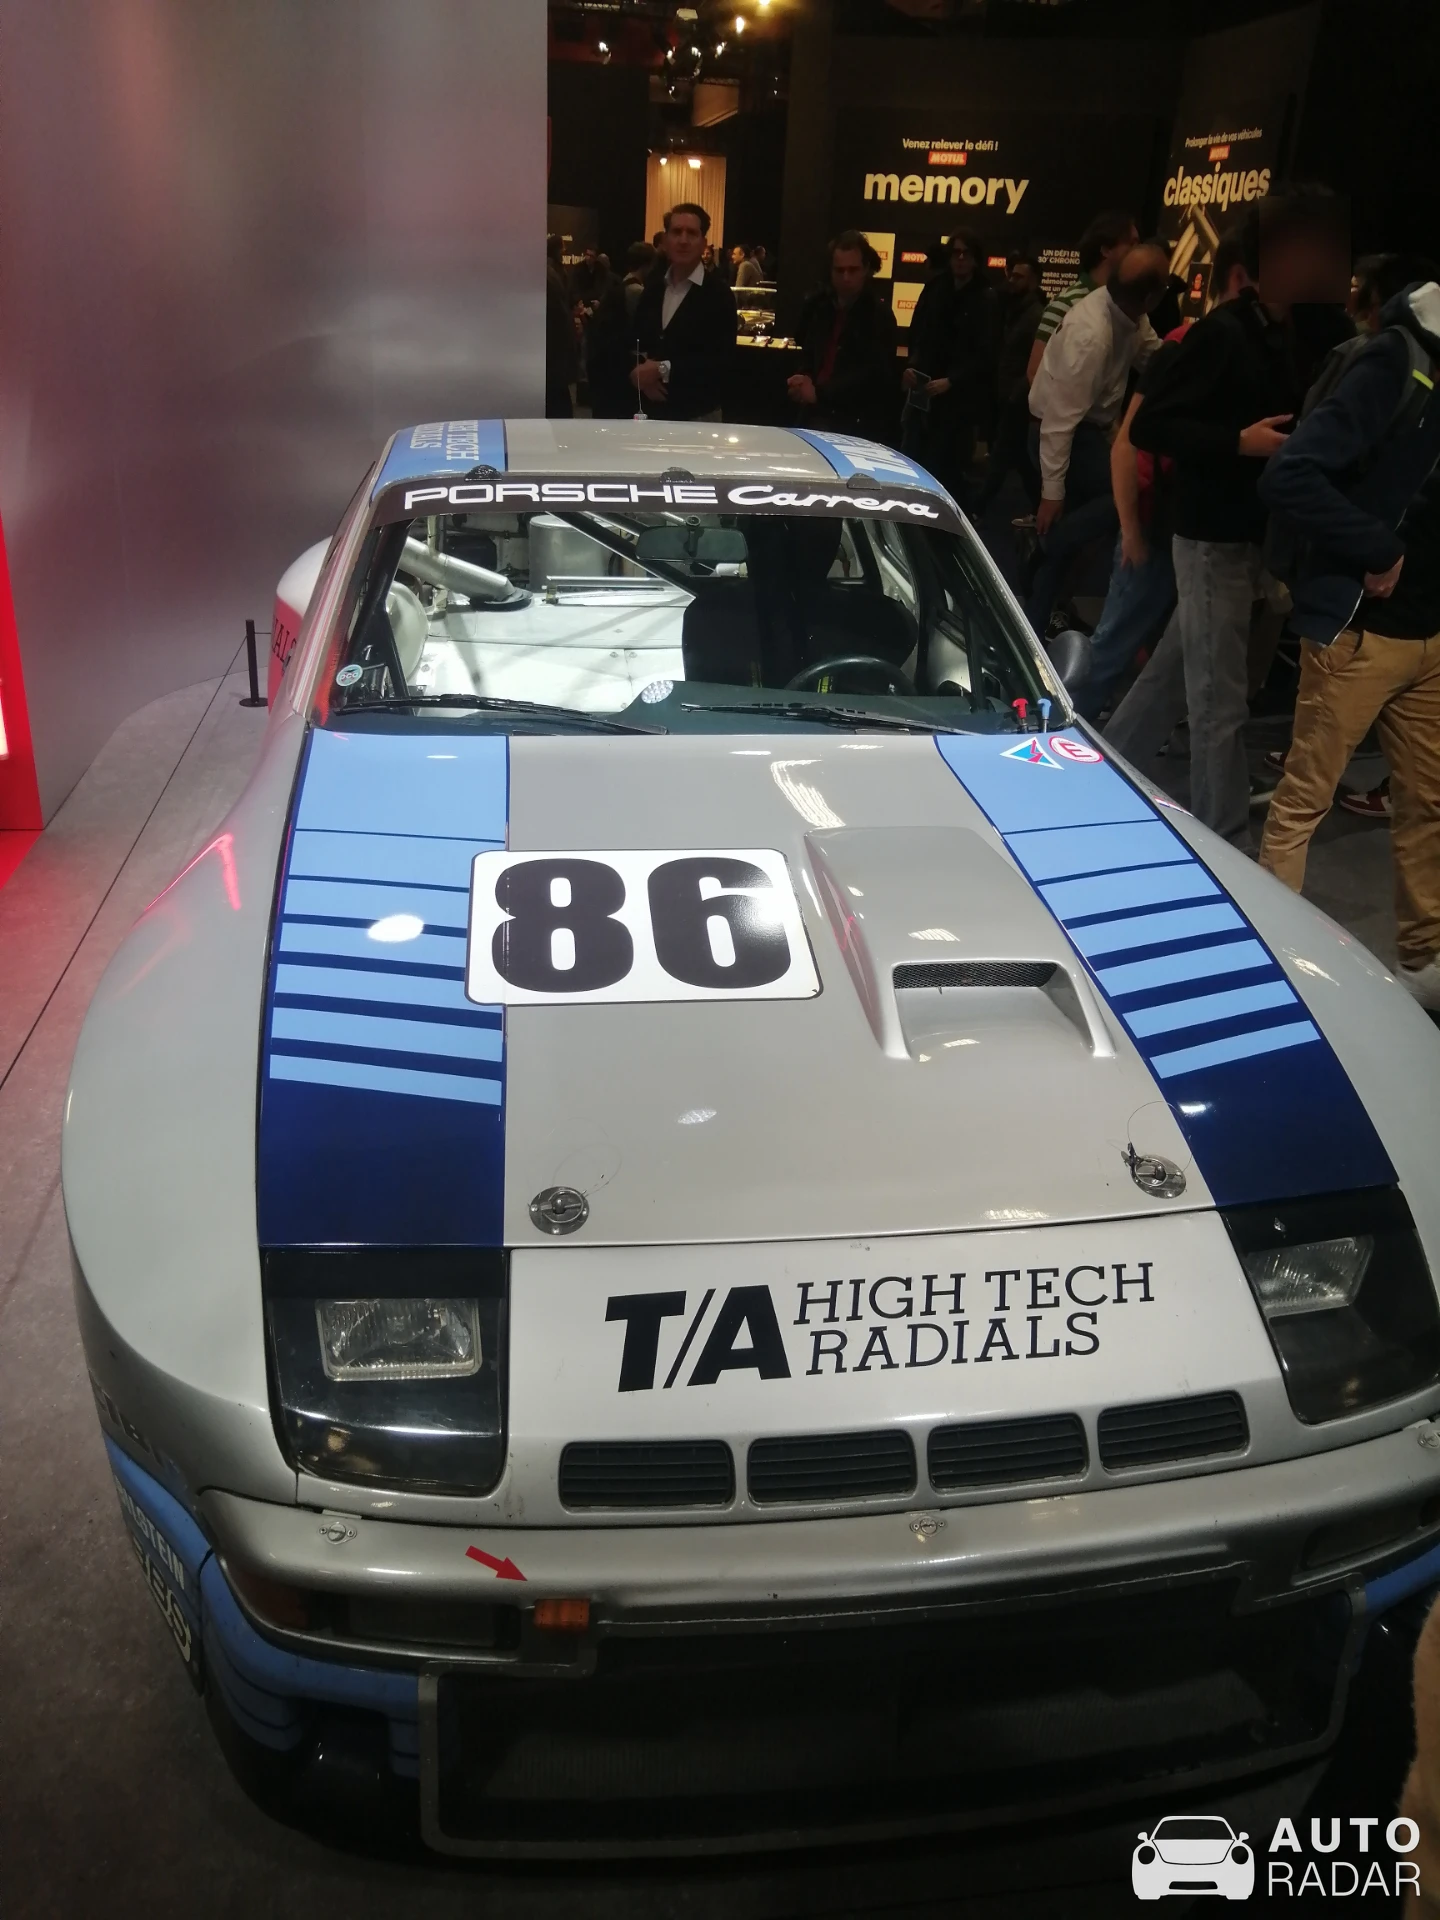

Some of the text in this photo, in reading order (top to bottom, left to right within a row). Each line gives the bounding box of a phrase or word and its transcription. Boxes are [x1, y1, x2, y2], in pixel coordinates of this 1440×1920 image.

[902, 138, 930, 149] Venez
[931, 139, 963, 150] relever
[965, 140, 974, 150] le
[975, 140, 993, 151] défi
[930, 153, 965, 163] MOTUL
[864, 172, 1030, 214] memory
[1163, 161, 1271, 212] classiques
[903, 253, 926, 262] MOTU
[989, 257, 1006, 266] MOT
[898, 301, 918, 309] MOT
[404, 483, 939, 519] PORSCHE Carrera
[491, 856, 792, 993] 86
[605, 1262, 1155, 1393] T/A HIGH TECH
[805, 1311, 1101, 1376] RADIALS
